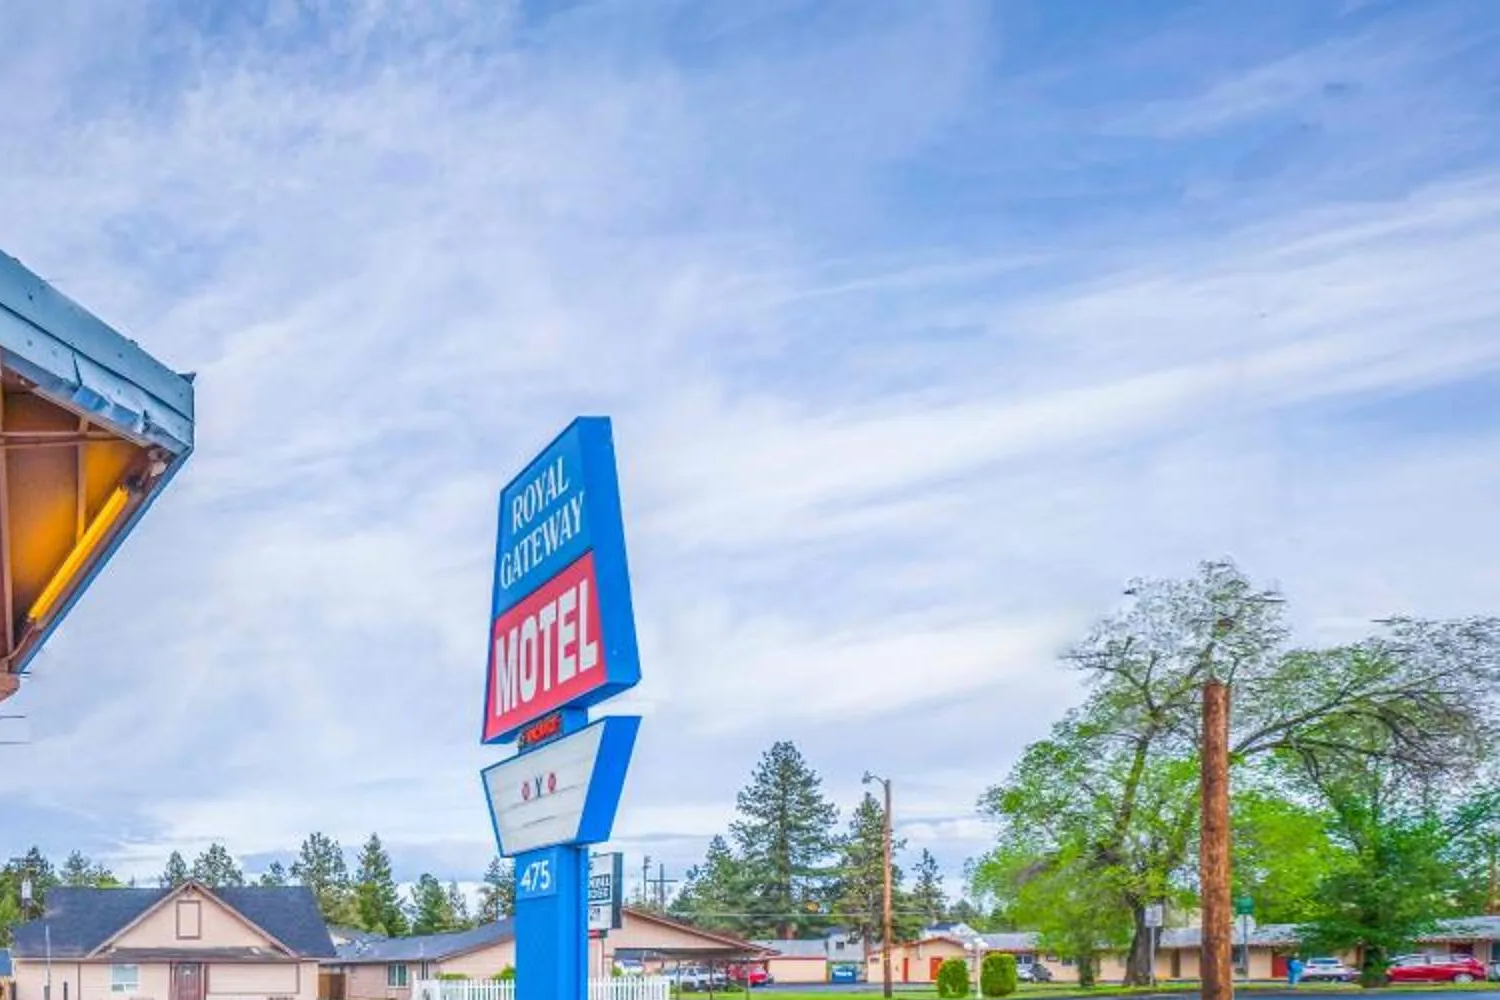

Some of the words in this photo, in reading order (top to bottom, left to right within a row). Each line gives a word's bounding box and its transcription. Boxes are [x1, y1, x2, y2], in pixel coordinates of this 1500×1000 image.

[511, 456, 570, 535] ROYAL
[501, 490, 585, 590] GATEWAY
[495, 578, 598, 717] MOTEL
[521, 772, 557, 801] OYO
[520, 859, 551, 892] 475
